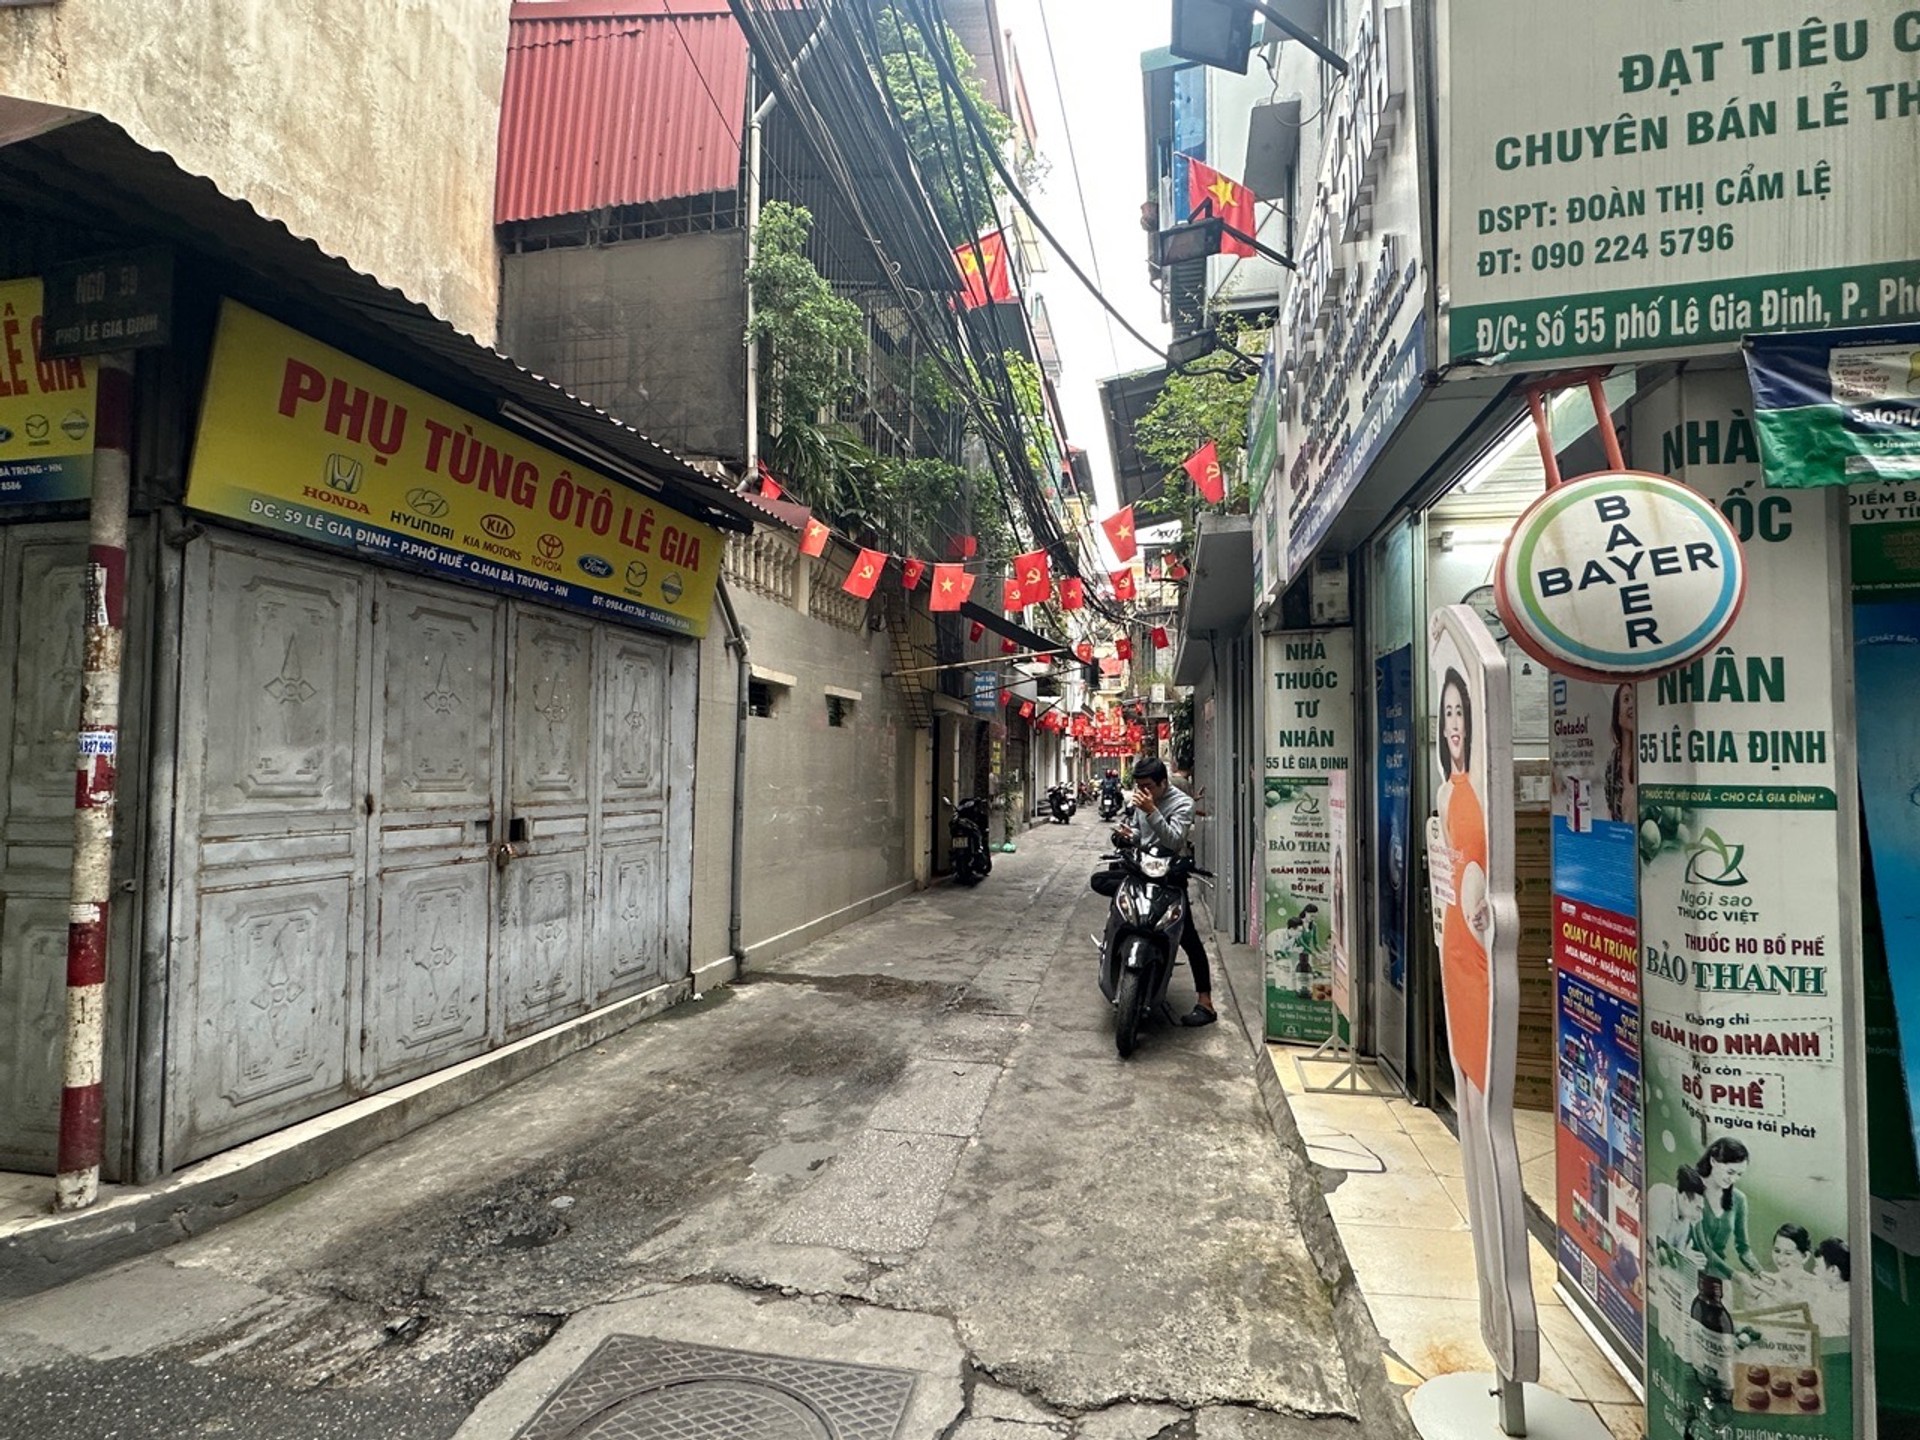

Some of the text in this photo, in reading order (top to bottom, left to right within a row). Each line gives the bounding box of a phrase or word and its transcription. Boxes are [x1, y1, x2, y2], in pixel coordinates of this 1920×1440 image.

[1619, 42, 1723, 96] ĐẠT
[1742, 16, 1869, 75] TIÊU
[1495, 113, 1668, 171] CHUYÊN
[1687, 98, 1777, 146] BÁN
[1797, 80, 1848, 130] LẺ
[1478, 160, 1832, 235] DSPT: ĐOÀN THỊ CẨM LỆ
[1477, 224, 1734, 277] ĐT: 090 224 5796
[1476, 277, 1920, 353] Đ/C: Số 55 phố Lê Gia Định, P. Ph
[102, 320, 123, 340] GIA
[1400, 344, 1417, 394] NAM
[1663, 409, 1759, 476] NHÀ
[11, 464, 43, 476] TRƯNG
[48, 463, 63, 473] HN
[278, 358, 701, 572] PHỤ TÙNG ÔTÔ LÊ GIA
[303, 486, 371, 515] HONDA
[390, 510, 454, 541] HYUNDAI
[486, 518, 509, 533] KIA
[1862, 508, 1883, 521] UY
[250, 499, 569, 598] ĐC: 59 LÊ GIA ĐỊNH P.PHỐ HUẾ Q.HAI BÀ TRƯNG HN
[462, 534, 522, 562] KIA MOTORS
[530, 555, 563, 574] TOYOTA
[582, 556, 607, 576] Ford
[1538, 542, 1719, 598] BAYER
[1595, 495, 1663, 648] BAYER
[1285, 639, 1327, 661] NHÀ
[1275, 665, 1338, 690] THUỐC
[1658, 647, 1785, 706] NHÂN
[1294, 699, 1320, 718] TƯ
[1279, 726, 1334, 748] NHÂN
[1554, 716, 1588, 736] Glotadol
[1639, 725, 1826, 771] 55 LÊ GIA ĐỊNH
[1265, 757, 1279, 769] 55
[1282, 754, 1295, 770] LÊ
[1298, 757, 1317, 769] GIA
[1691, 789, 1712, 802] QUẢ
[1720, 792, 1745, 802] CHO
[1748, 789, 1764, 802] CẢ
[1766, 792, 1785, 802] GIA
[1788, 790, 1816, 803] ĐÌNH
[1269, 836, 1296, 852] BẢO
[1296, 866, 1308, 875] HO
[1305, 881, 1325, 895] PHẾ
[1680, 888, 1753, 907] Ngôi sao
[1677, 904, 1759, 925] THUỐC VIỆT
[1562, 922, 1588, 946] QUAY
[1589, 930, 1602, 951] LÀ
[1685, 931, 1825, 956] THUỐC HO BỔ PHẾ
[1565, 944, 1636, 985] MUA NGAY NHẬN QUẢ
[1646, 940, 1827, 996] BẢO THANH
[1685, 1012, 1750, 1028] Không chỉ
[1650, 1020, 1820, 1057] GIẢM HO NHANH
[1691, 1058, 1742, 1077] Mà còn
[1681, 1074, 1765, 1109] BỔ PHẾ
[1714, 1115, 1753, 1131] ngừa
[1757, 1120, 1777, 1133] tái
[1781, 1122, 1817, 1139] phát
